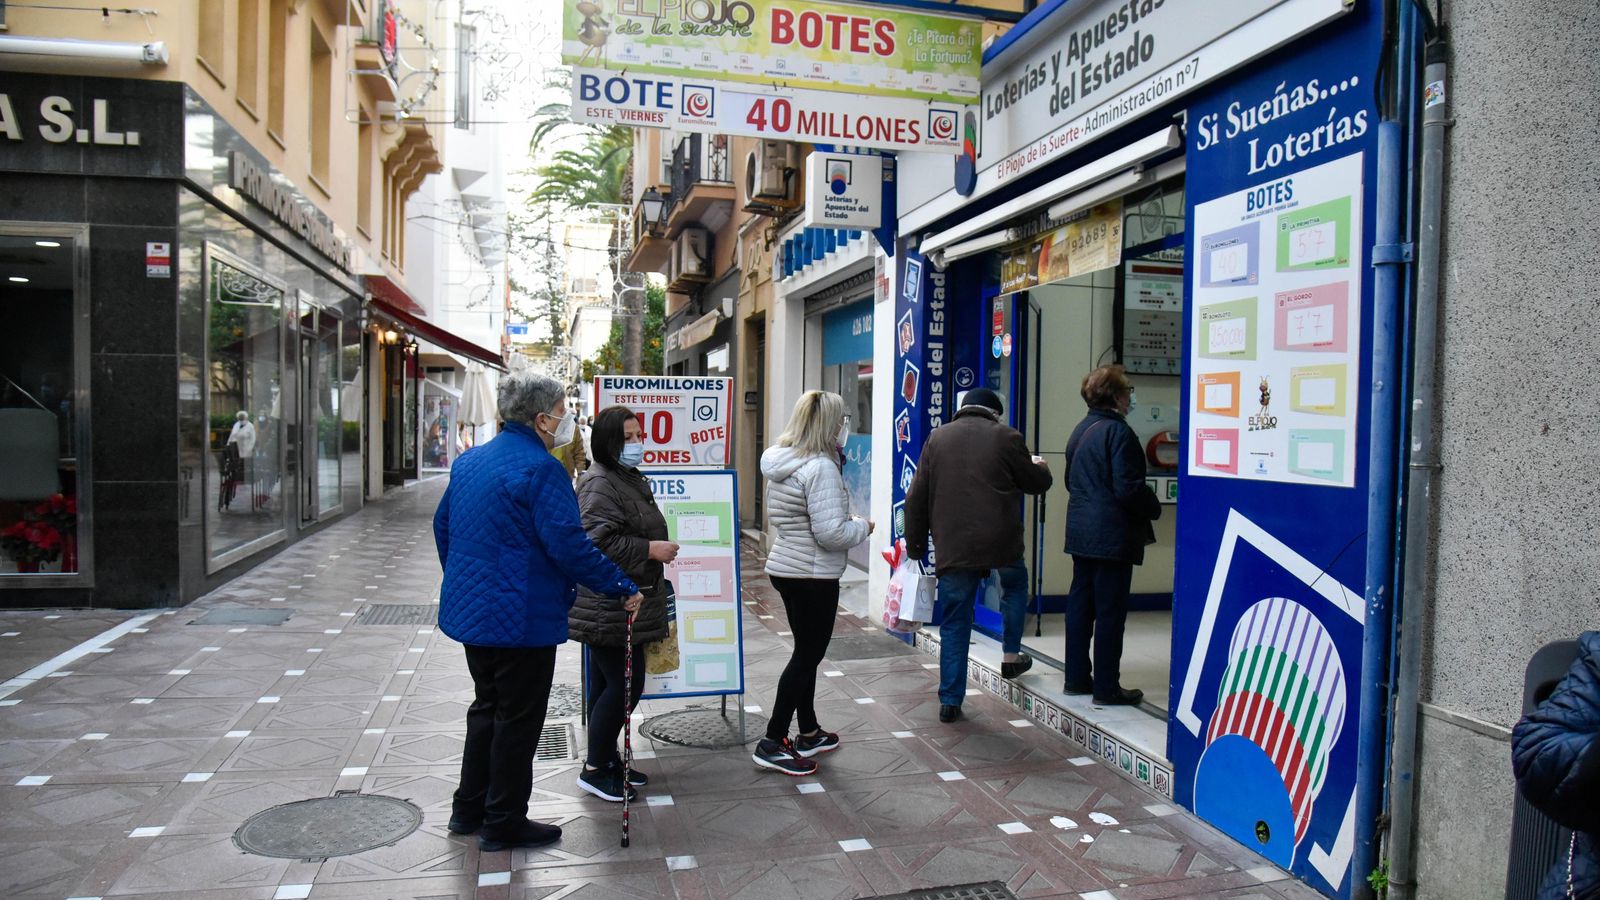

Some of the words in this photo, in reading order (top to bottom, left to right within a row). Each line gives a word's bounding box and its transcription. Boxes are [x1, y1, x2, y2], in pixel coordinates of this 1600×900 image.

[616, 19, 643, 35] de
[651, 16, 673, 36] la
[679, 19, 752, 37] suerte
[770, 8, 896, 56] BOTES
[931, 48, 972, 63] Fortuna?
[1049, 77, 1075, 116] del
[1079, 30, 1155, 98] Estado
[580, 74, 674, 109] BOTE
[986, 60, 1047, 121] Loterías
[1050, 56, 1062, 78] y
[39, 96, 141, 146] S.L.
[587, 108, 614, 119] ESTE
[619, 110, 664, 123] VIERNES
[678, 117, 717, 127] Euromillones
[746, 98, 792, 133] 40
[797, 110, 920, 144] MILLONES
[1197, 113, 1218, 151] Si
[1247, 105, 1368, 176] Loterías
[925, 139, 960, 148] Euromillones
[997, 161, 1005, 180] El
[1005, 151, 1026, 178] Piojo
[1027, 146, 1038, 165] de
[1039, 141, 1048, 159] la
[1048, 125, 1080, 153] Suerte
[825, 195, 853, 203] Loterías
[1246, 178, 1294, 213] BOTES
[824, 212, 848, 220] Estado
[825, 204, 857, 213] Apuestas
[1072, 223, 1107, 253] 92689
[928, 342, 944, 376] del
[603, 378, 724, 391] EUROMILLONES
[615, 395, 638, 404] ESTE
[640, 395, 680, 404] VIERNES
[690, 426, 725, 445] BOTE
[641, 450, 691, 464] ONES
[649, 479, 685, 495] OTES
